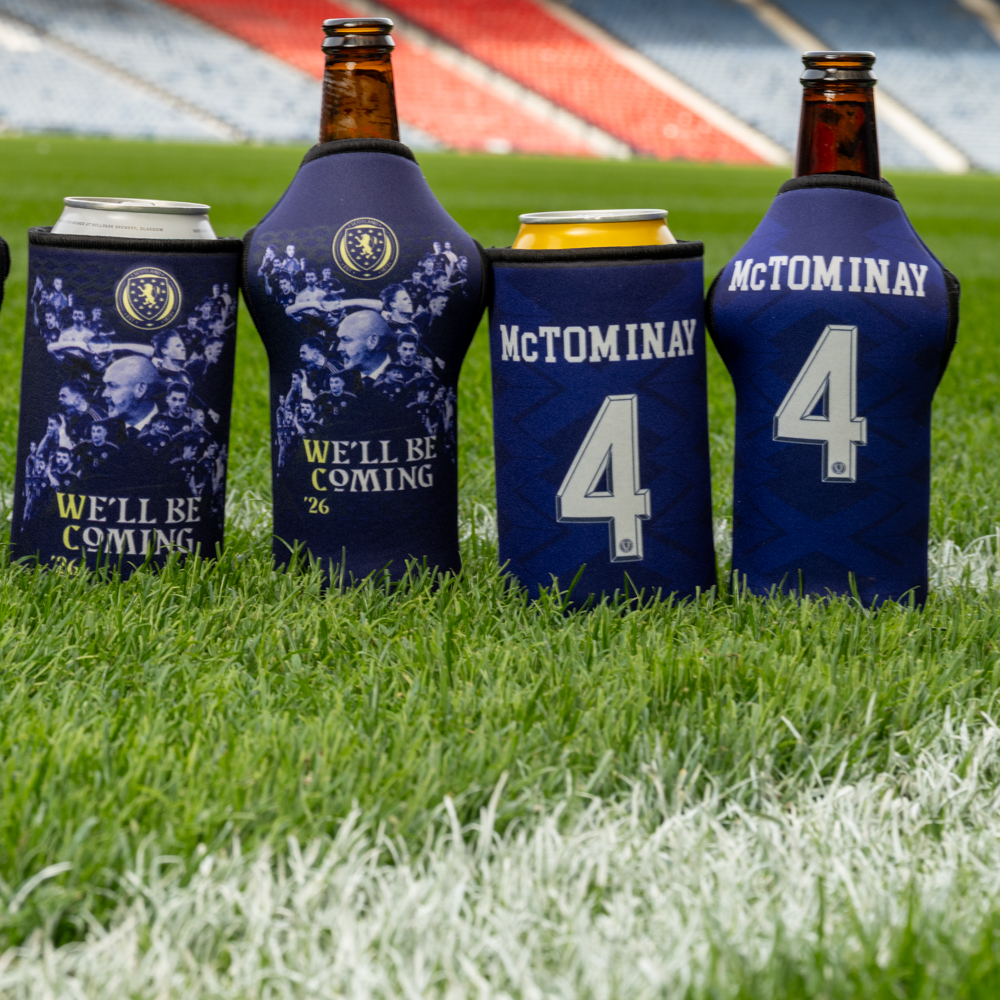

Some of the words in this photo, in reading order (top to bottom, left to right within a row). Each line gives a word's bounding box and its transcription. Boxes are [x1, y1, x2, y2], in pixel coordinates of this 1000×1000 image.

[728, 254, 928, 298] McTOMINAY
[500, 318, 697, 364] McTOMINAY
[772, 324, 868, 483] 4
[303, 438, 398, 465] WE'LL
[405, 435, 437, 463] BE
[311, 464, 434, 492] COMING
[555, 393, 651, 563] 4
[56, 492, 157, 524] WE'LL
[165, 496, 202, 524] BE
[303, 496, 330, 515] '26
[62, 524, 194, 556] COMING
